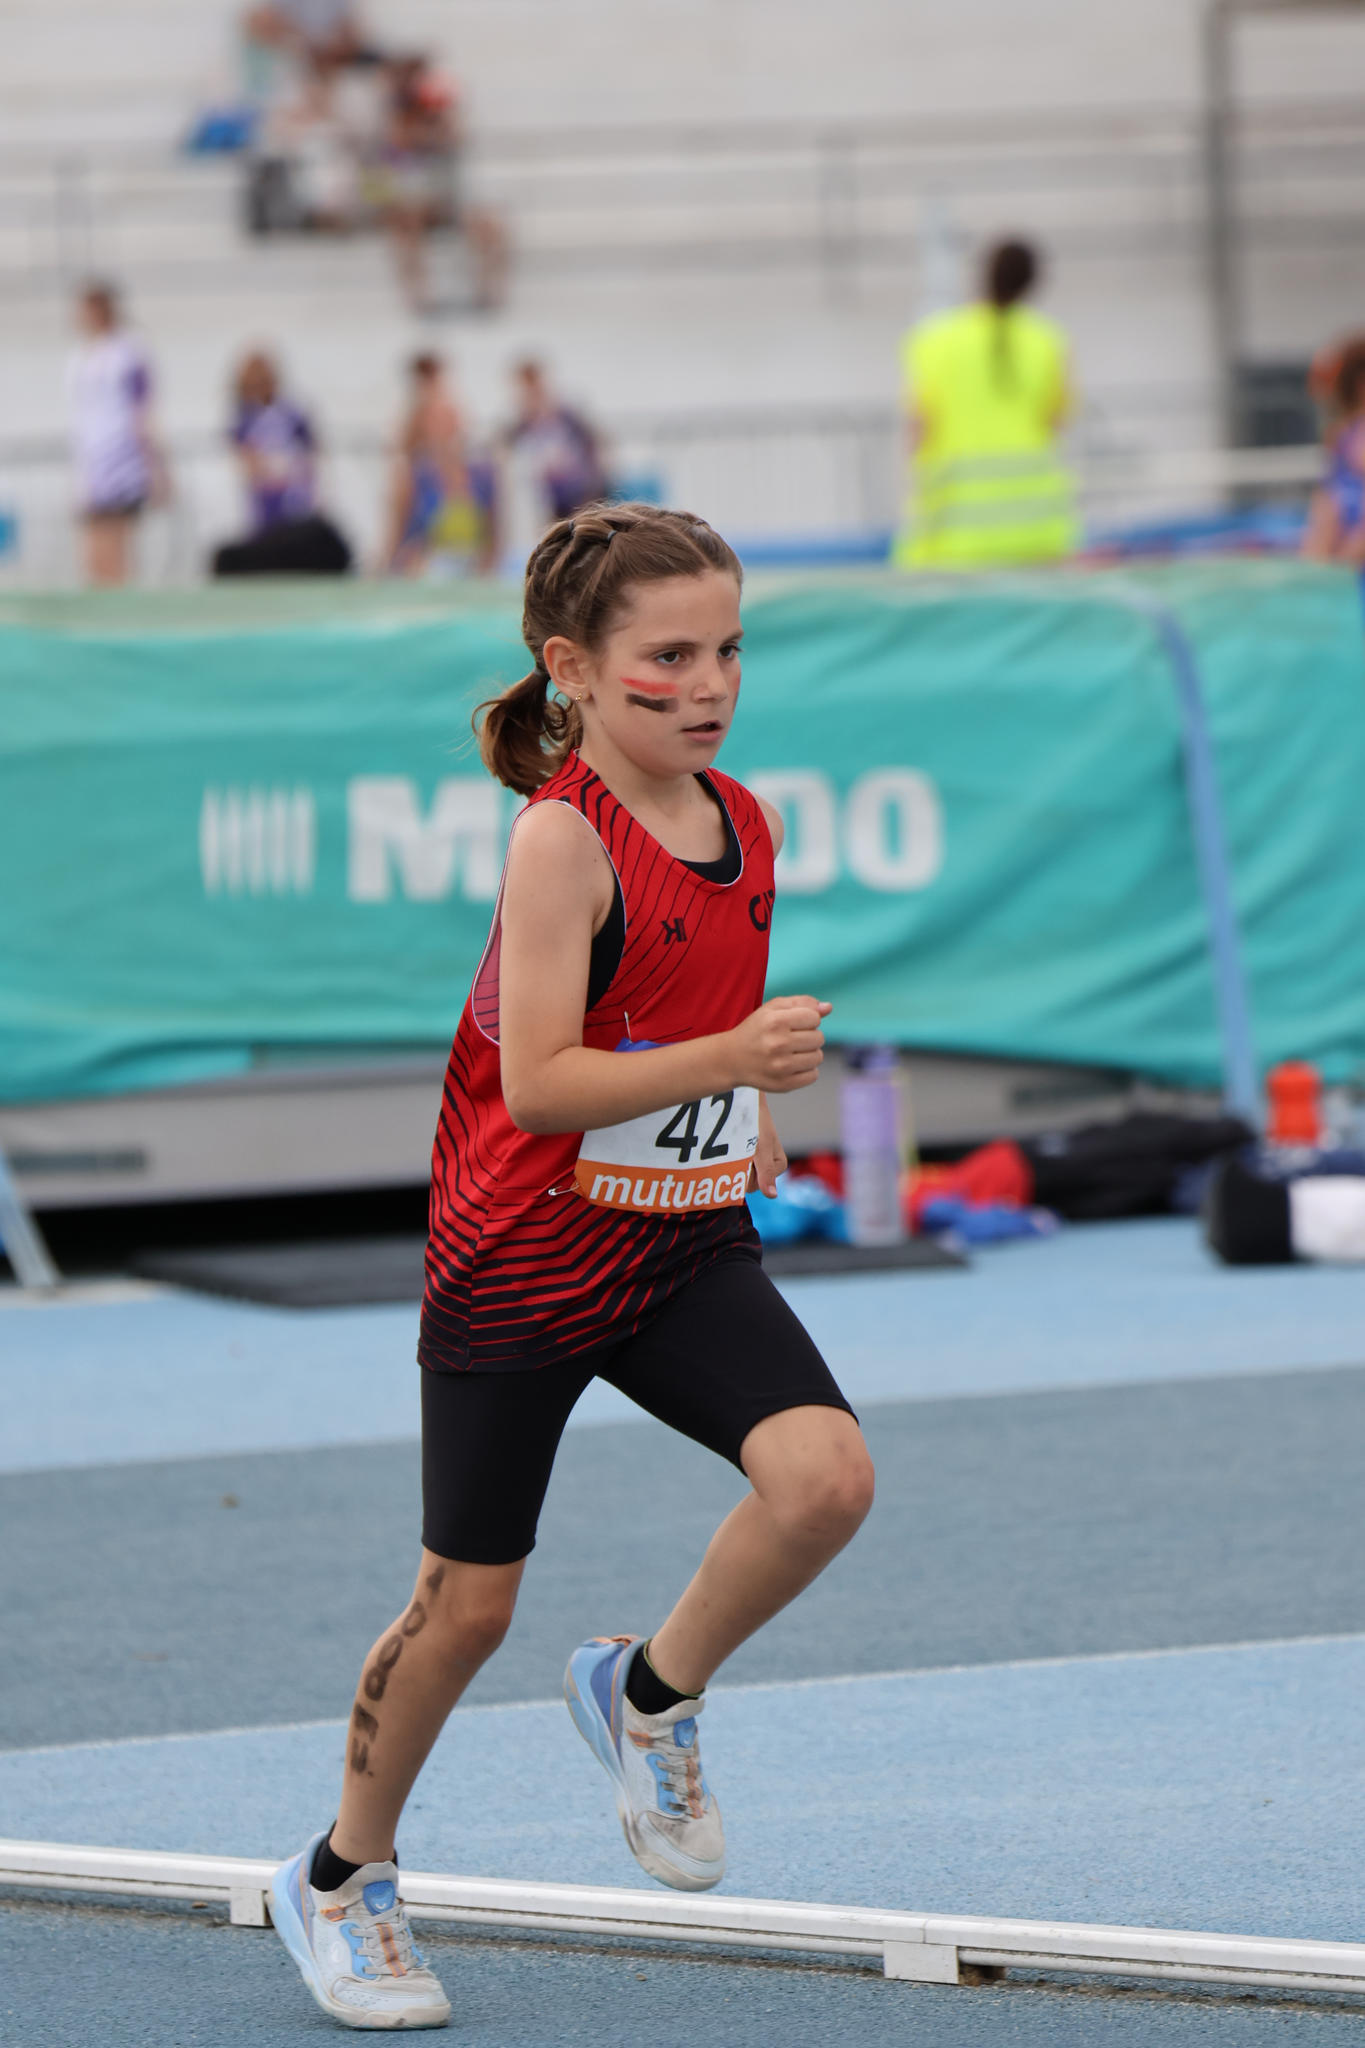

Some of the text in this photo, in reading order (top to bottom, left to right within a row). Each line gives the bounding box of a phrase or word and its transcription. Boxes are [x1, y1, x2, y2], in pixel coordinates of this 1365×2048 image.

[348, 767, 945, 904] MDO
[655, 1088, 734, 1163] 42
[589, 1161, 752, 1208] mutuaca
